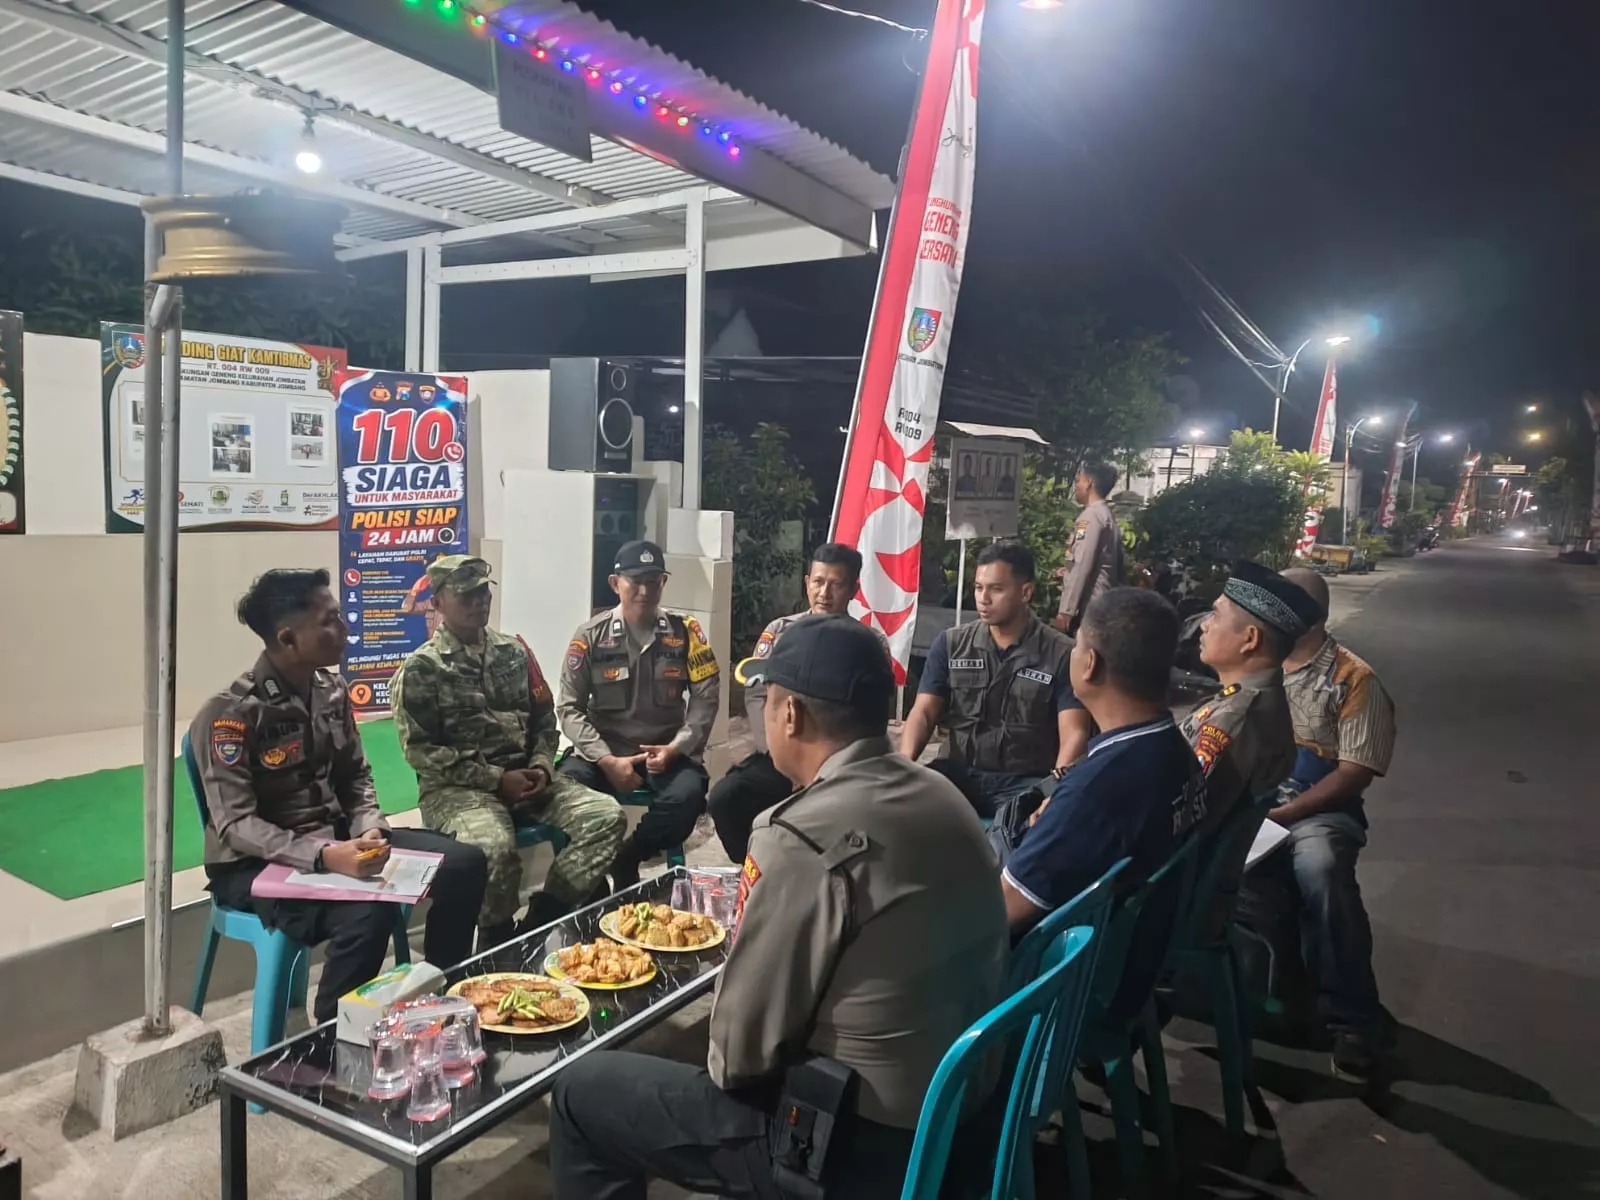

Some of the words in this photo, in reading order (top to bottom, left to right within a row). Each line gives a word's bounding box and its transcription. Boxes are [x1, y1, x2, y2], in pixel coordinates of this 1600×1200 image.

[217, 343, 246, 363] GIAT
[247, 348, 312, 369] KAMTIBMAS
[222, 364, 238, 373] 004
[255, 366, 270, 375] 009
[353, 408, 456, 464] 110
[355, 465, 450, 493] SIAGA
[354, 493, 389, 503] UNTUK
[391, 489, 458, 501] MASYARAKAT
[351, 510, 411, 530] POLISI
[414, 507, 457, 526] SIAP
[367, 531, 390, 546] 24
[395, 529, 434, 544] JAM
